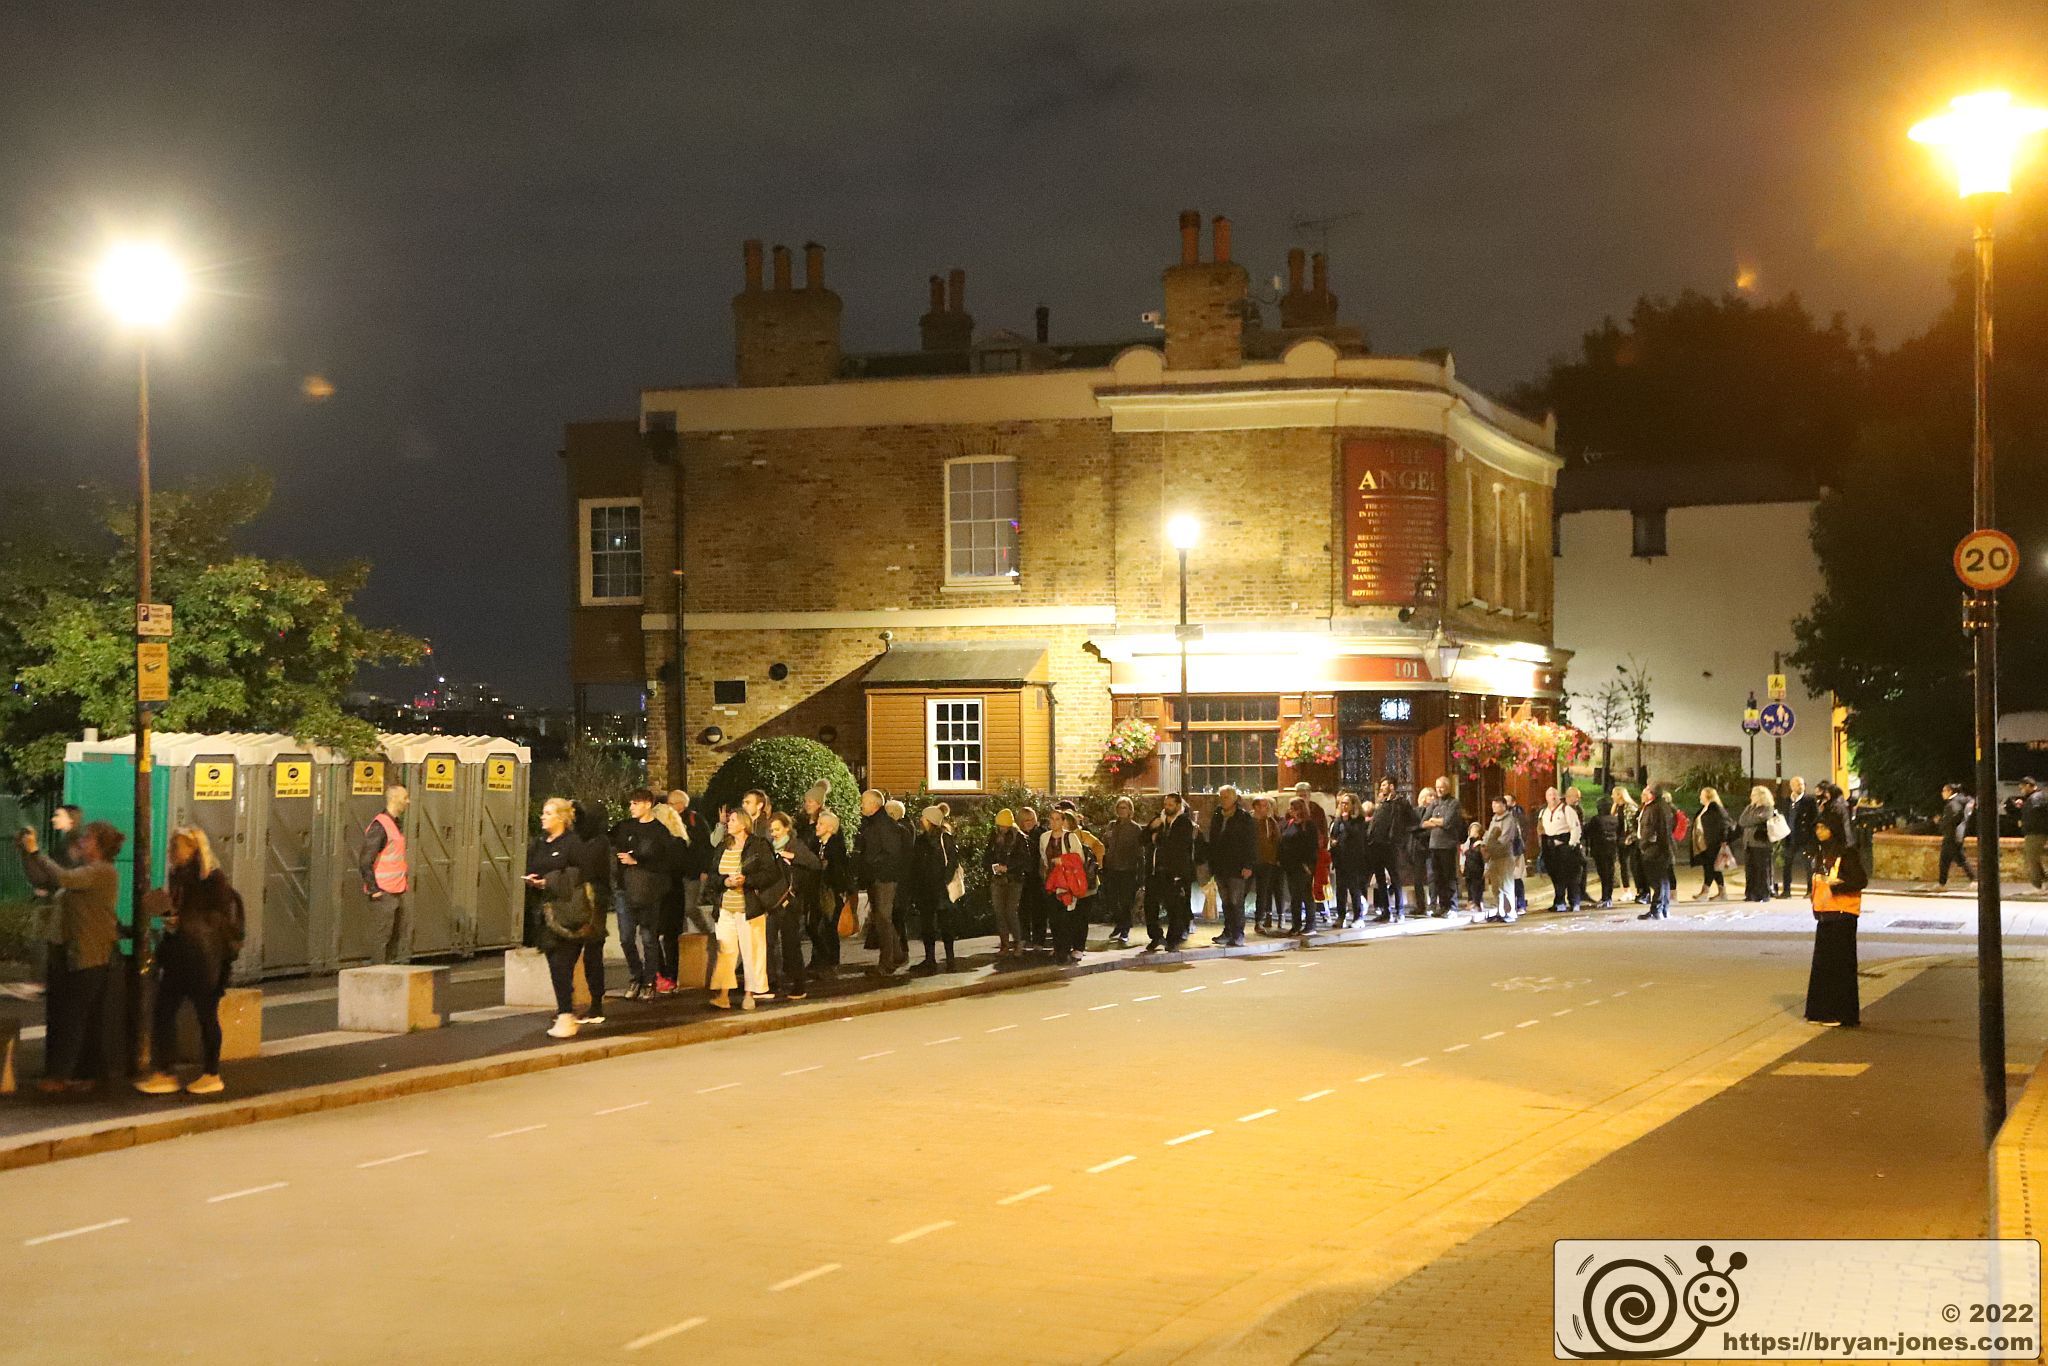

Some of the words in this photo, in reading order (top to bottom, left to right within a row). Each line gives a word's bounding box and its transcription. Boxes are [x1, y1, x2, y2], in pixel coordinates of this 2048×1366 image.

[1965, 547, 2009, 572] 20
[140, 606, 148, 620] P
[1394, 661, 1418, 678] 101
